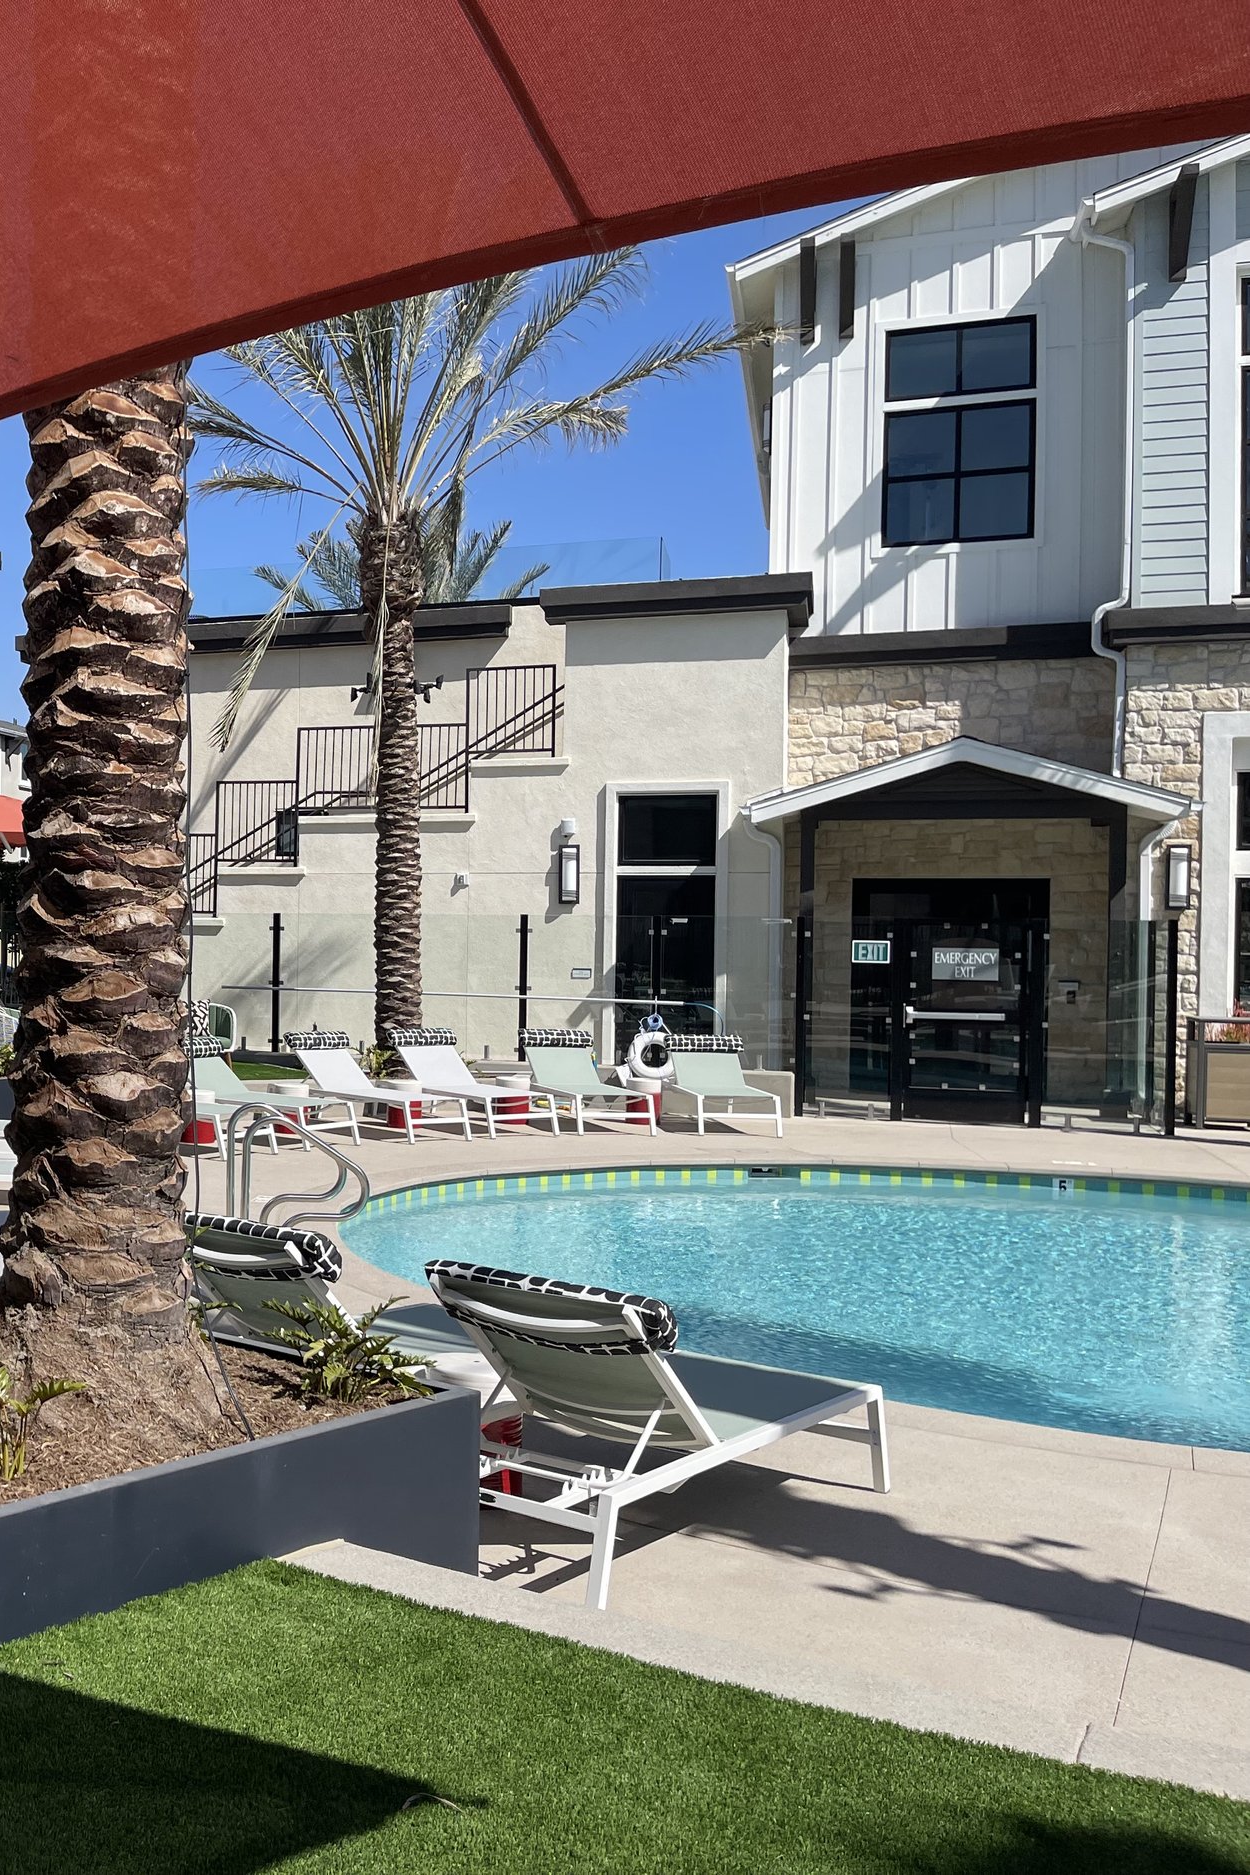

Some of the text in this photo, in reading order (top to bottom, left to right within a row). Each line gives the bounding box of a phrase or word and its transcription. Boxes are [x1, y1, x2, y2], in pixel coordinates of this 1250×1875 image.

[858, 943, 886, 961] EXIT
[934, 952, 997, 965] EMERGENCY
[954, 966, 976, 978] EXIT
[1059, 1179, 1067, 1191] 5
